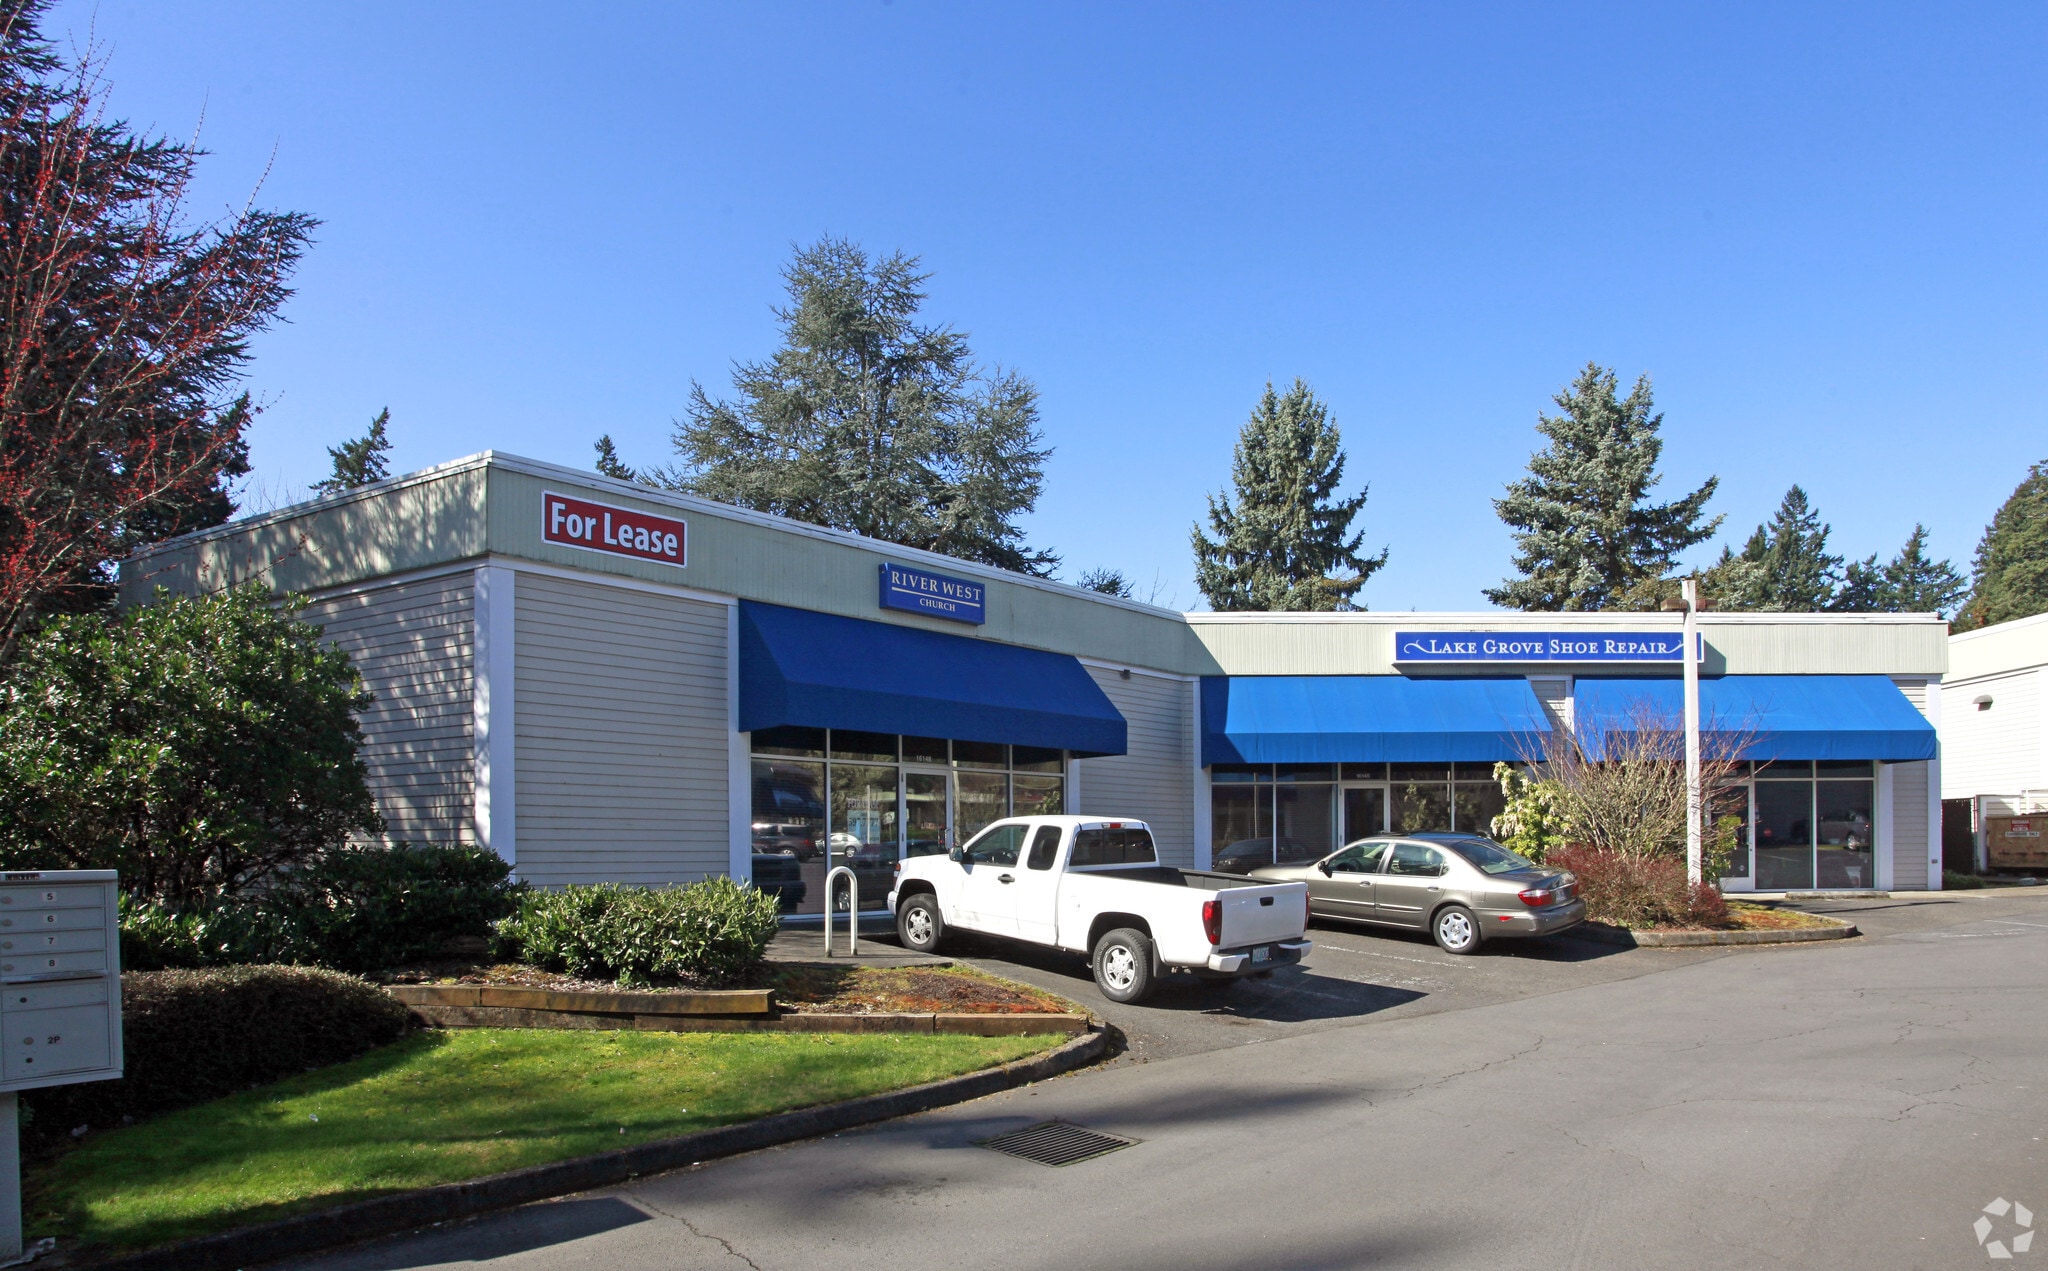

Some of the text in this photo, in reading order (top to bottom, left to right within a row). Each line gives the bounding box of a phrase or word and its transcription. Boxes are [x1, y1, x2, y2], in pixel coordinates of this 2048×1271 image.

[551, 501, 679, 557] For Lease
[891, 571, 982, 601] RIVER WEST
[919, 597, 956, 612] CHURCH
[1429, 639, 1669, 654] LAKE GROVE SHOE REPAIR
[47, 892, 54, 900] 5
[47, 915, 54, 923] 6
[47, 937, 54, 945] 7
[48, 959, 55, 967] 8
[47, 1035, 61, 1044] 2P
